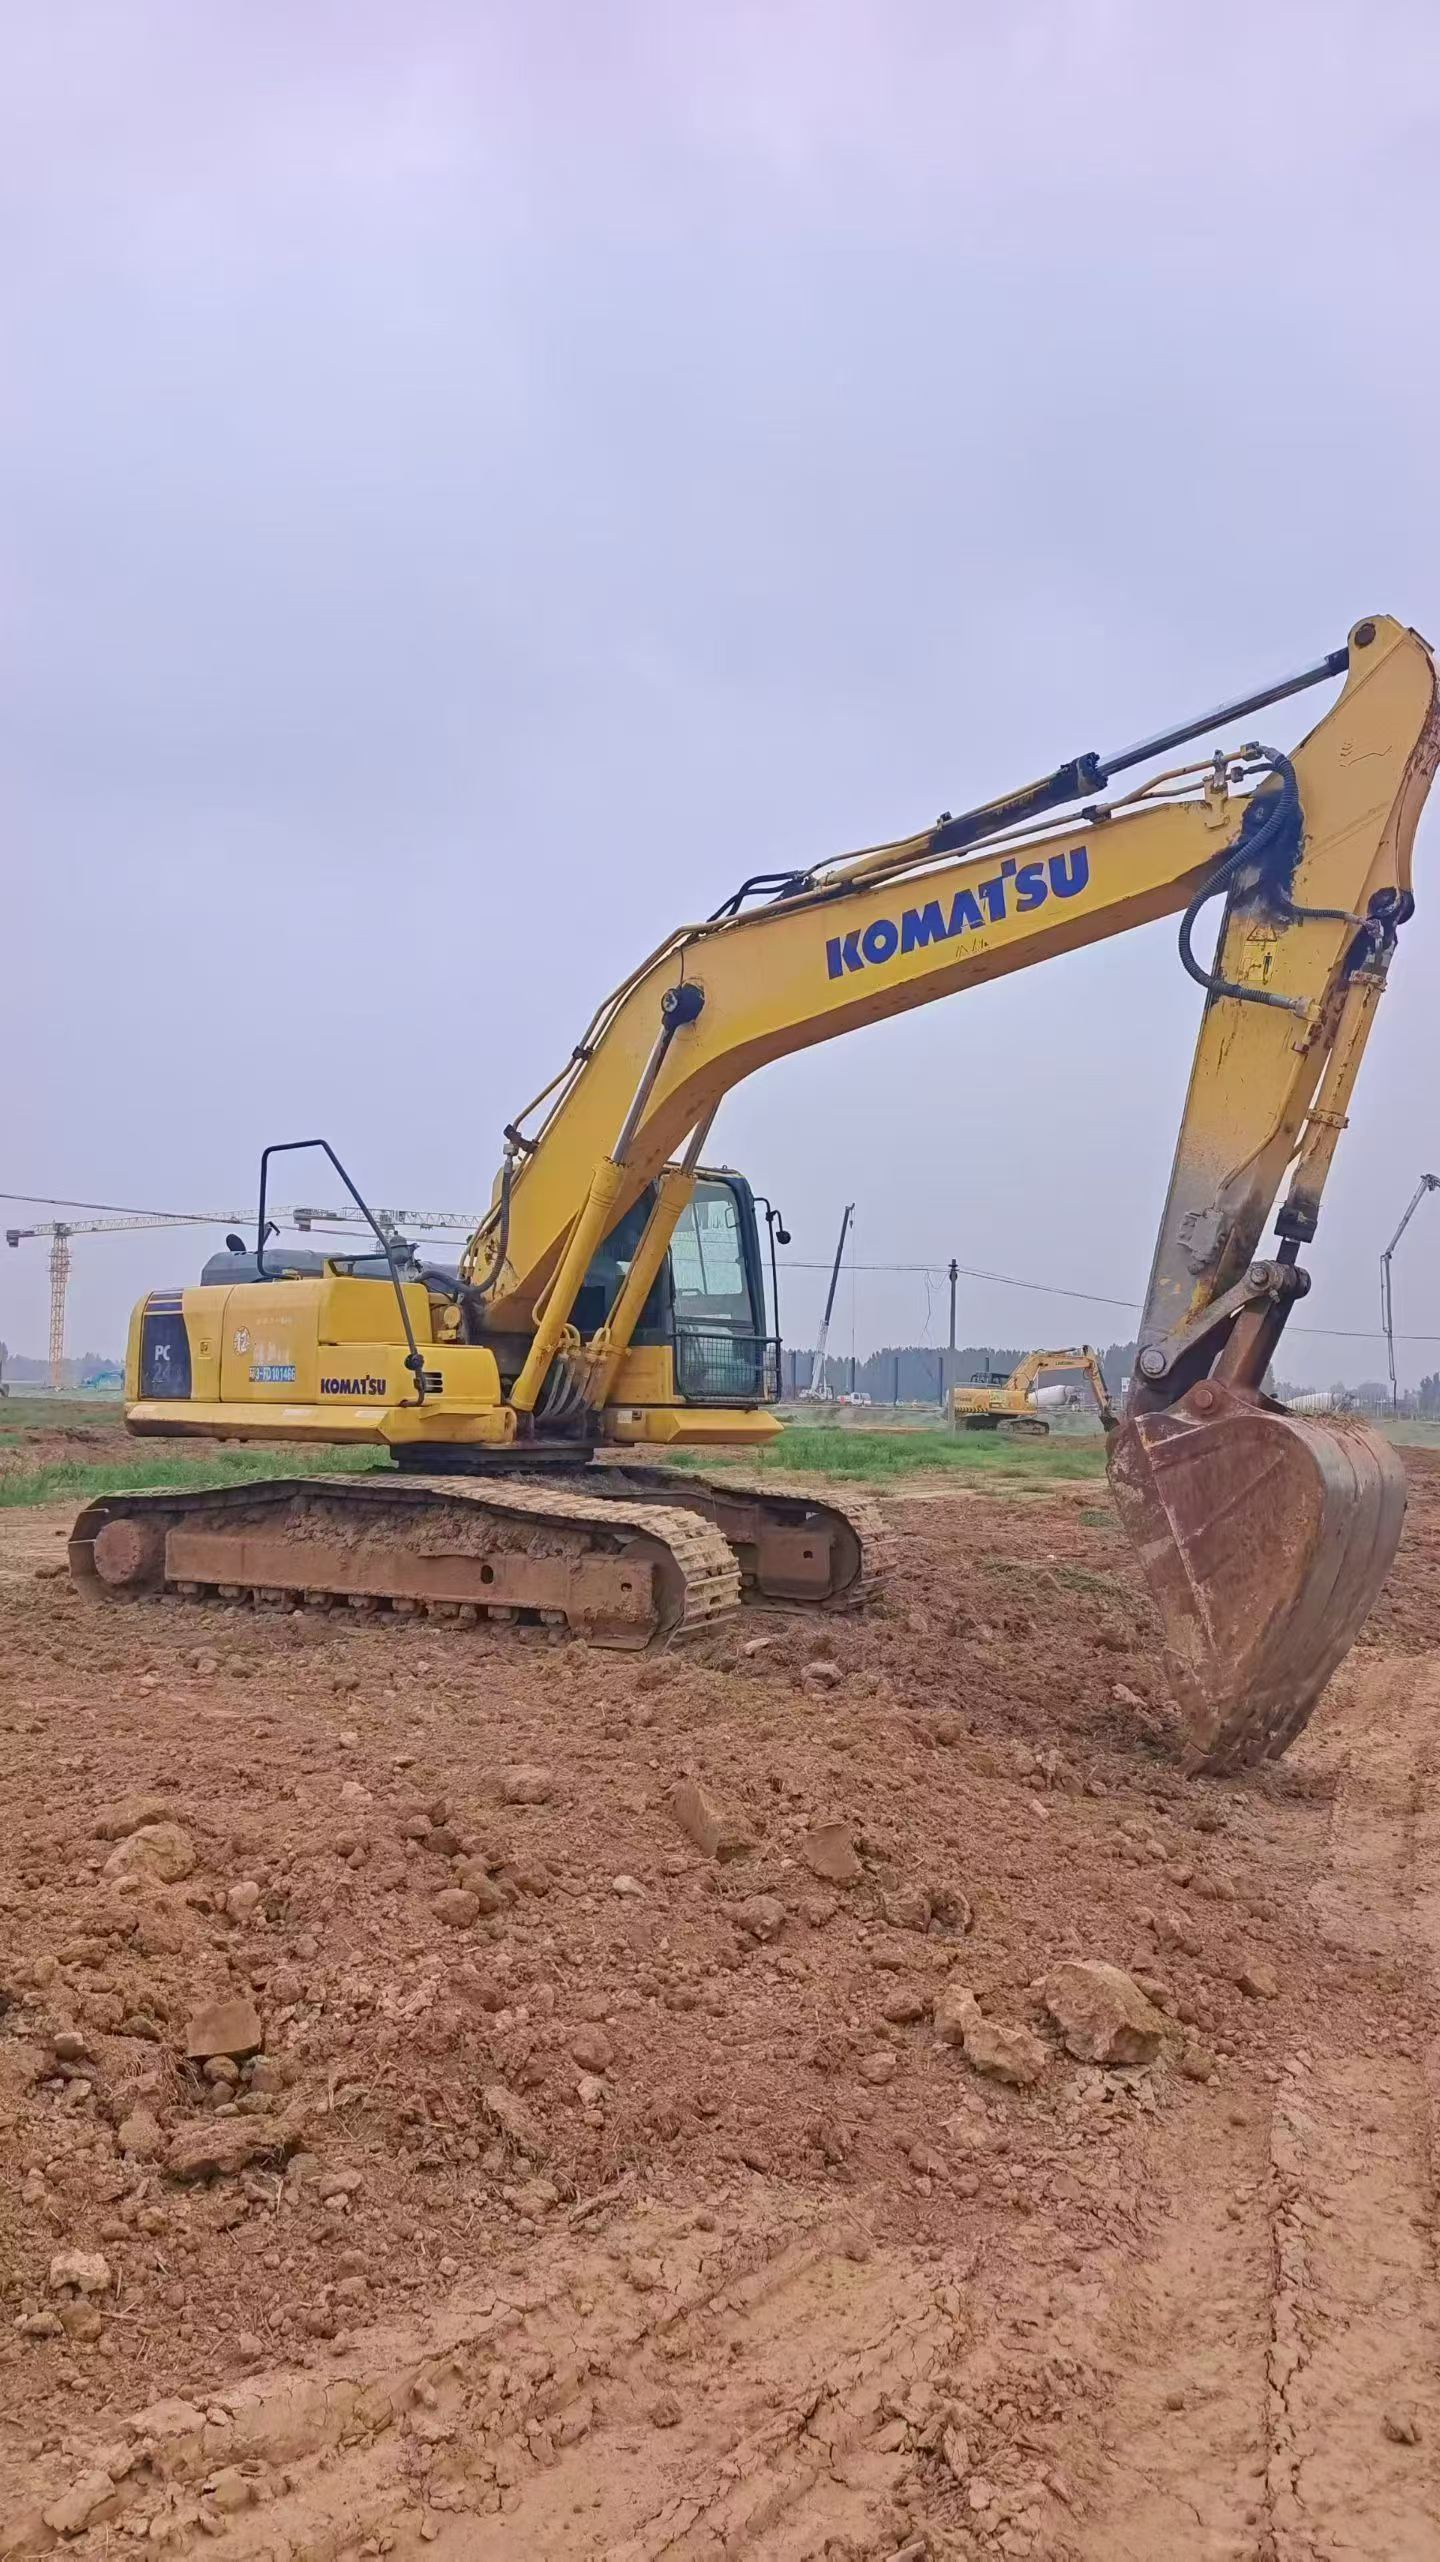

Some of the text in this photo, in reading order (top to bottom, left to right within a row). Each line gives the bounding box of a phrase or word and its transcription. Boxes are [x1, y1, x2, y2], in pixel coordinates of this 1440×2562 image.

[826, 846, 1090, 980] KOMATSU
[154, 1344, 171, 1361] PC
[320, 1374, 387, 1396] KOMATSU
